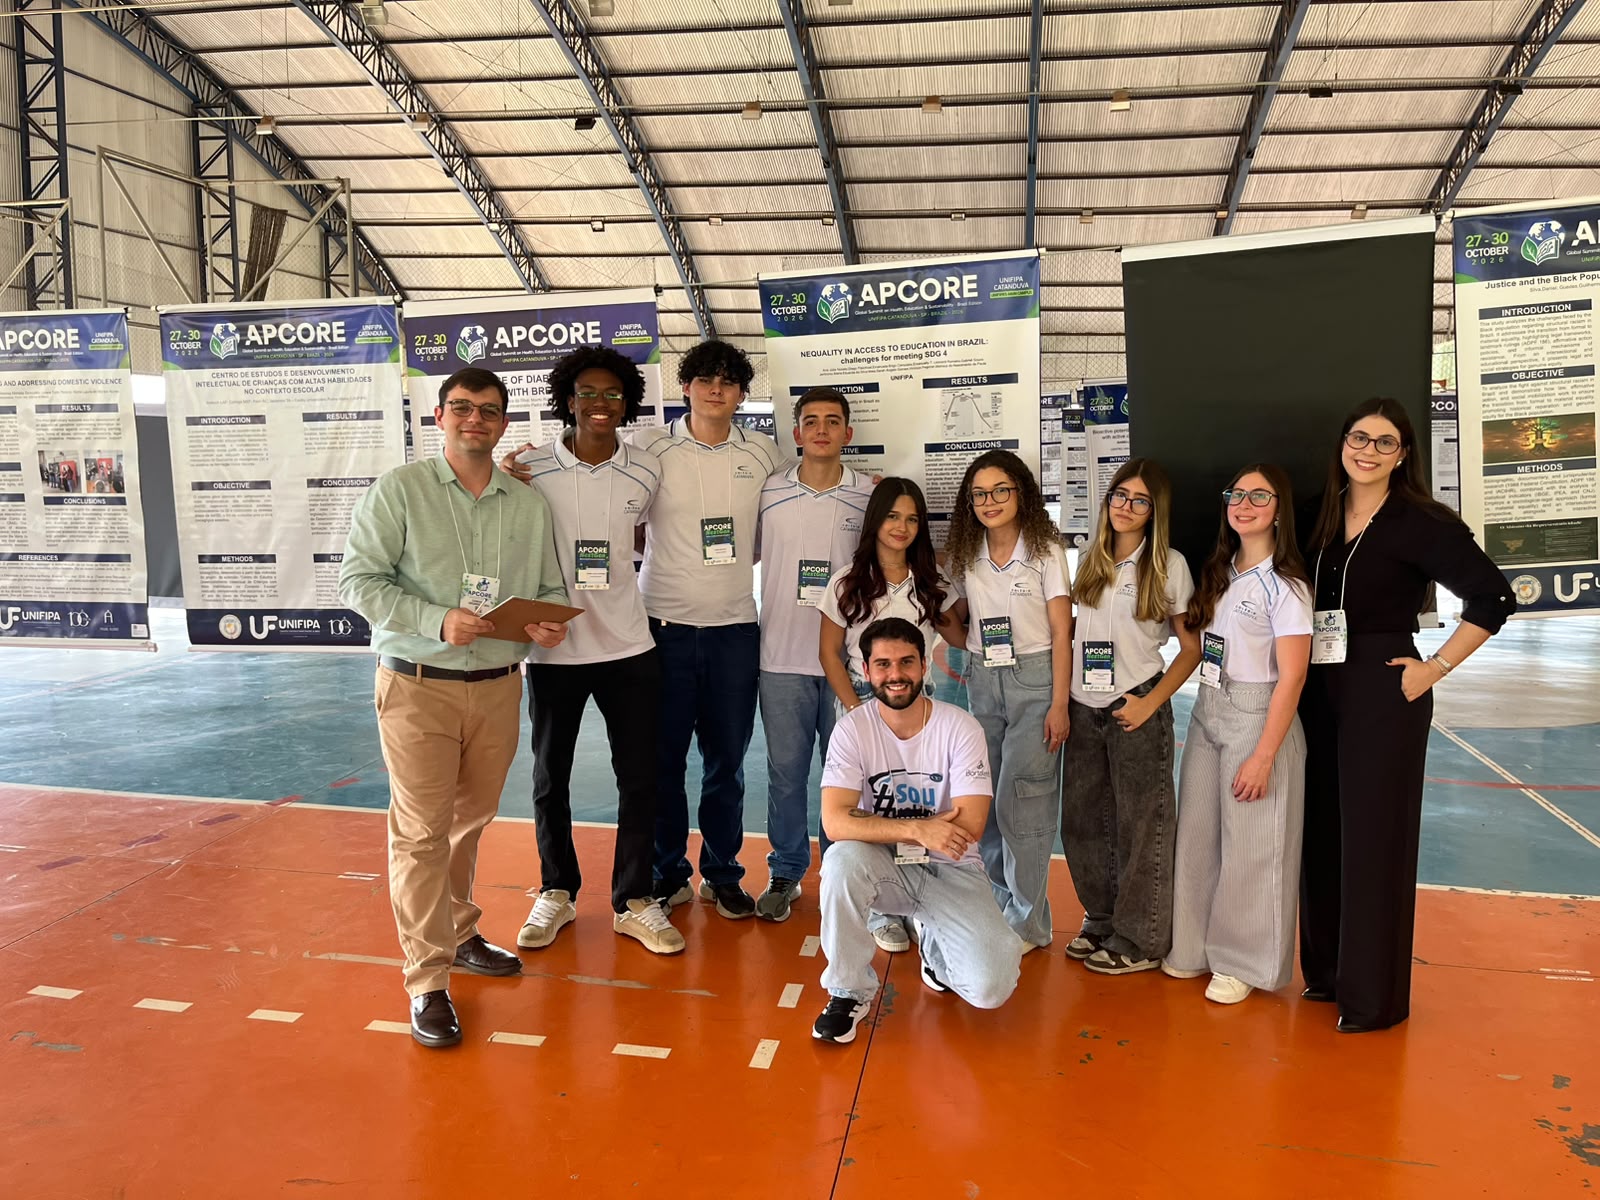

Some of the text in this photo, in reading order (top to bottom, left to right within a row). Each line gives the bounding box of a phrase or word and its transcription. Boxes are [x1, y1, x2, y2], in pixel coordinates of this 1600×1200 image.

[1466, 235, 1481, 247] 27
[1492, 232, 1508, 244] 30
[1465, 246, 1508, 258] OCTOBER
[859, 274, 978, 307] APCORE
[770, 295, 783, 306] 27
[792, 293, 805, 304] 30
[771, 305, 807, 315] OCTOBER
[1502, 304, 1571, 316] INTRODUCTION
[170, 331, 181, 341] 27
[188, 330, 200, 340] 30
[245, 321, 346, 345] APCORE
[493, 321, 601, 349] APCORE
[415, 335, 427, 346] 27
[434, 334, 446, 344] 30
[415, 346, 447, 355] OCTOBER
[801, 349, 842, 357] NEQUALITY
[854, 346, 886, 354] ACCESS
[901, 342, 945, 350] EDUCATION
[841, 355, 879, 364] challenges
[893, 352, 923, 361] meeting
[291, 368, 355, 376] DESENVOLVIMENTO
[1512, 369, 1564, 380] OBJECTIVE
[511, 376, 524, 384] OF
[526, 374, 548, 383] DIAB
[532, 387, 551, 395] BRE
[945, 441, 1002, 450] CONCLUSIONS
[1517, 463, 1563, 473] METHODS
[22, 611, 61, 621] UNIFIPA
[279, 619, 320, 629] UNIFIPA
[982, 623, 1009, 631] APCORE
